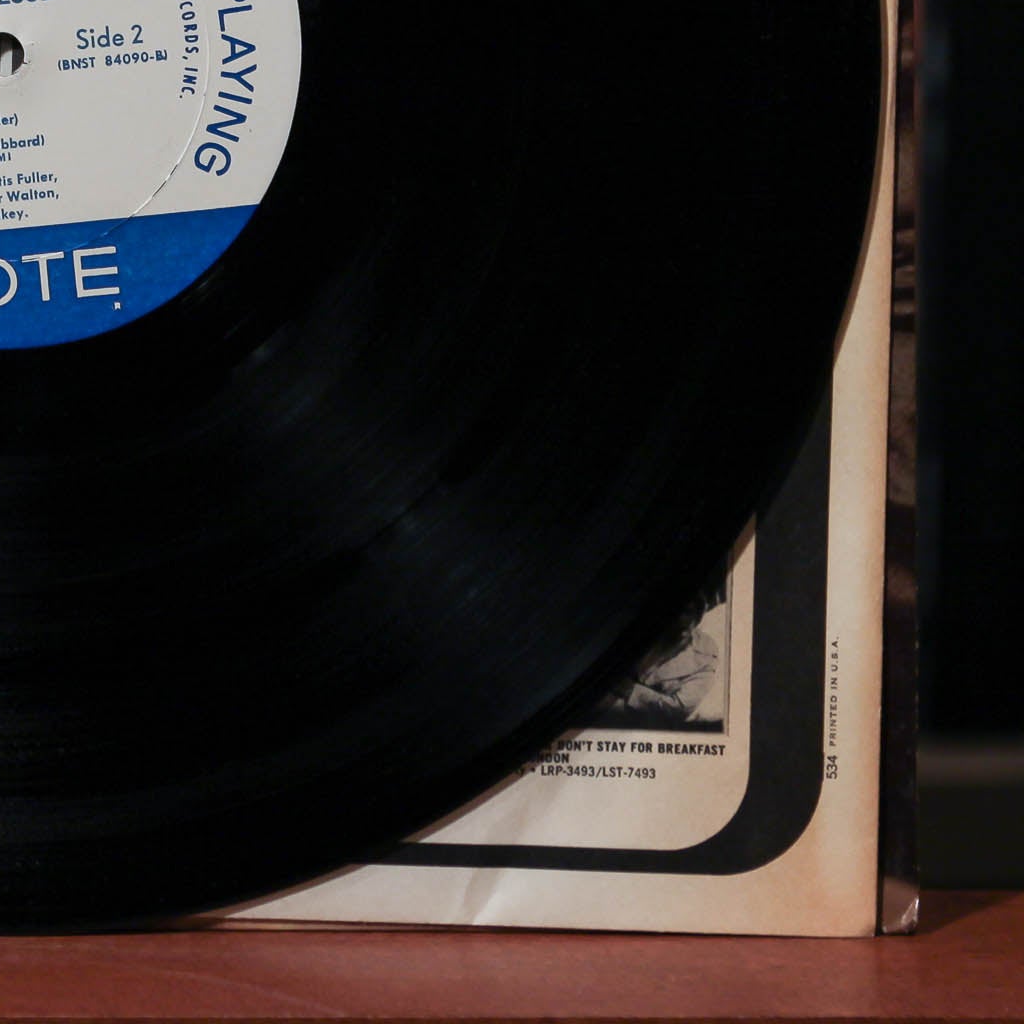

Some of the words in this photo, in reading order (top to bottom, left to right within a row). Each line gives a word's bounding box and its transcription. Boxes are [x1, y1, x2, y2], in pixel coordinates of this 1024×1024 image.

[76, 26, 125, 50] Side
[131, 24, 144, 45] 2
[57, 57, 96, 72] (BNST
[105, 49, 168, 67] 84090-B)
[179, 67, 198, 99] INC.
[17, 170, 58, 184] Fuller,
[7, 186, 60, 201] Walton,
[831, 636, 840, 672] U.S.A.
[830, 677, 838, 689] IN
[829, 695, 837, 747] PRINTED
[596, 740, 626, 752] STAY
[631, 741, 653, 754] FOR
[657, 742, 726, 756] BREAKFAST
[541, 764, 656, 779] LRP-3493/LST-7493
[826, 755, 838, 780] 534
